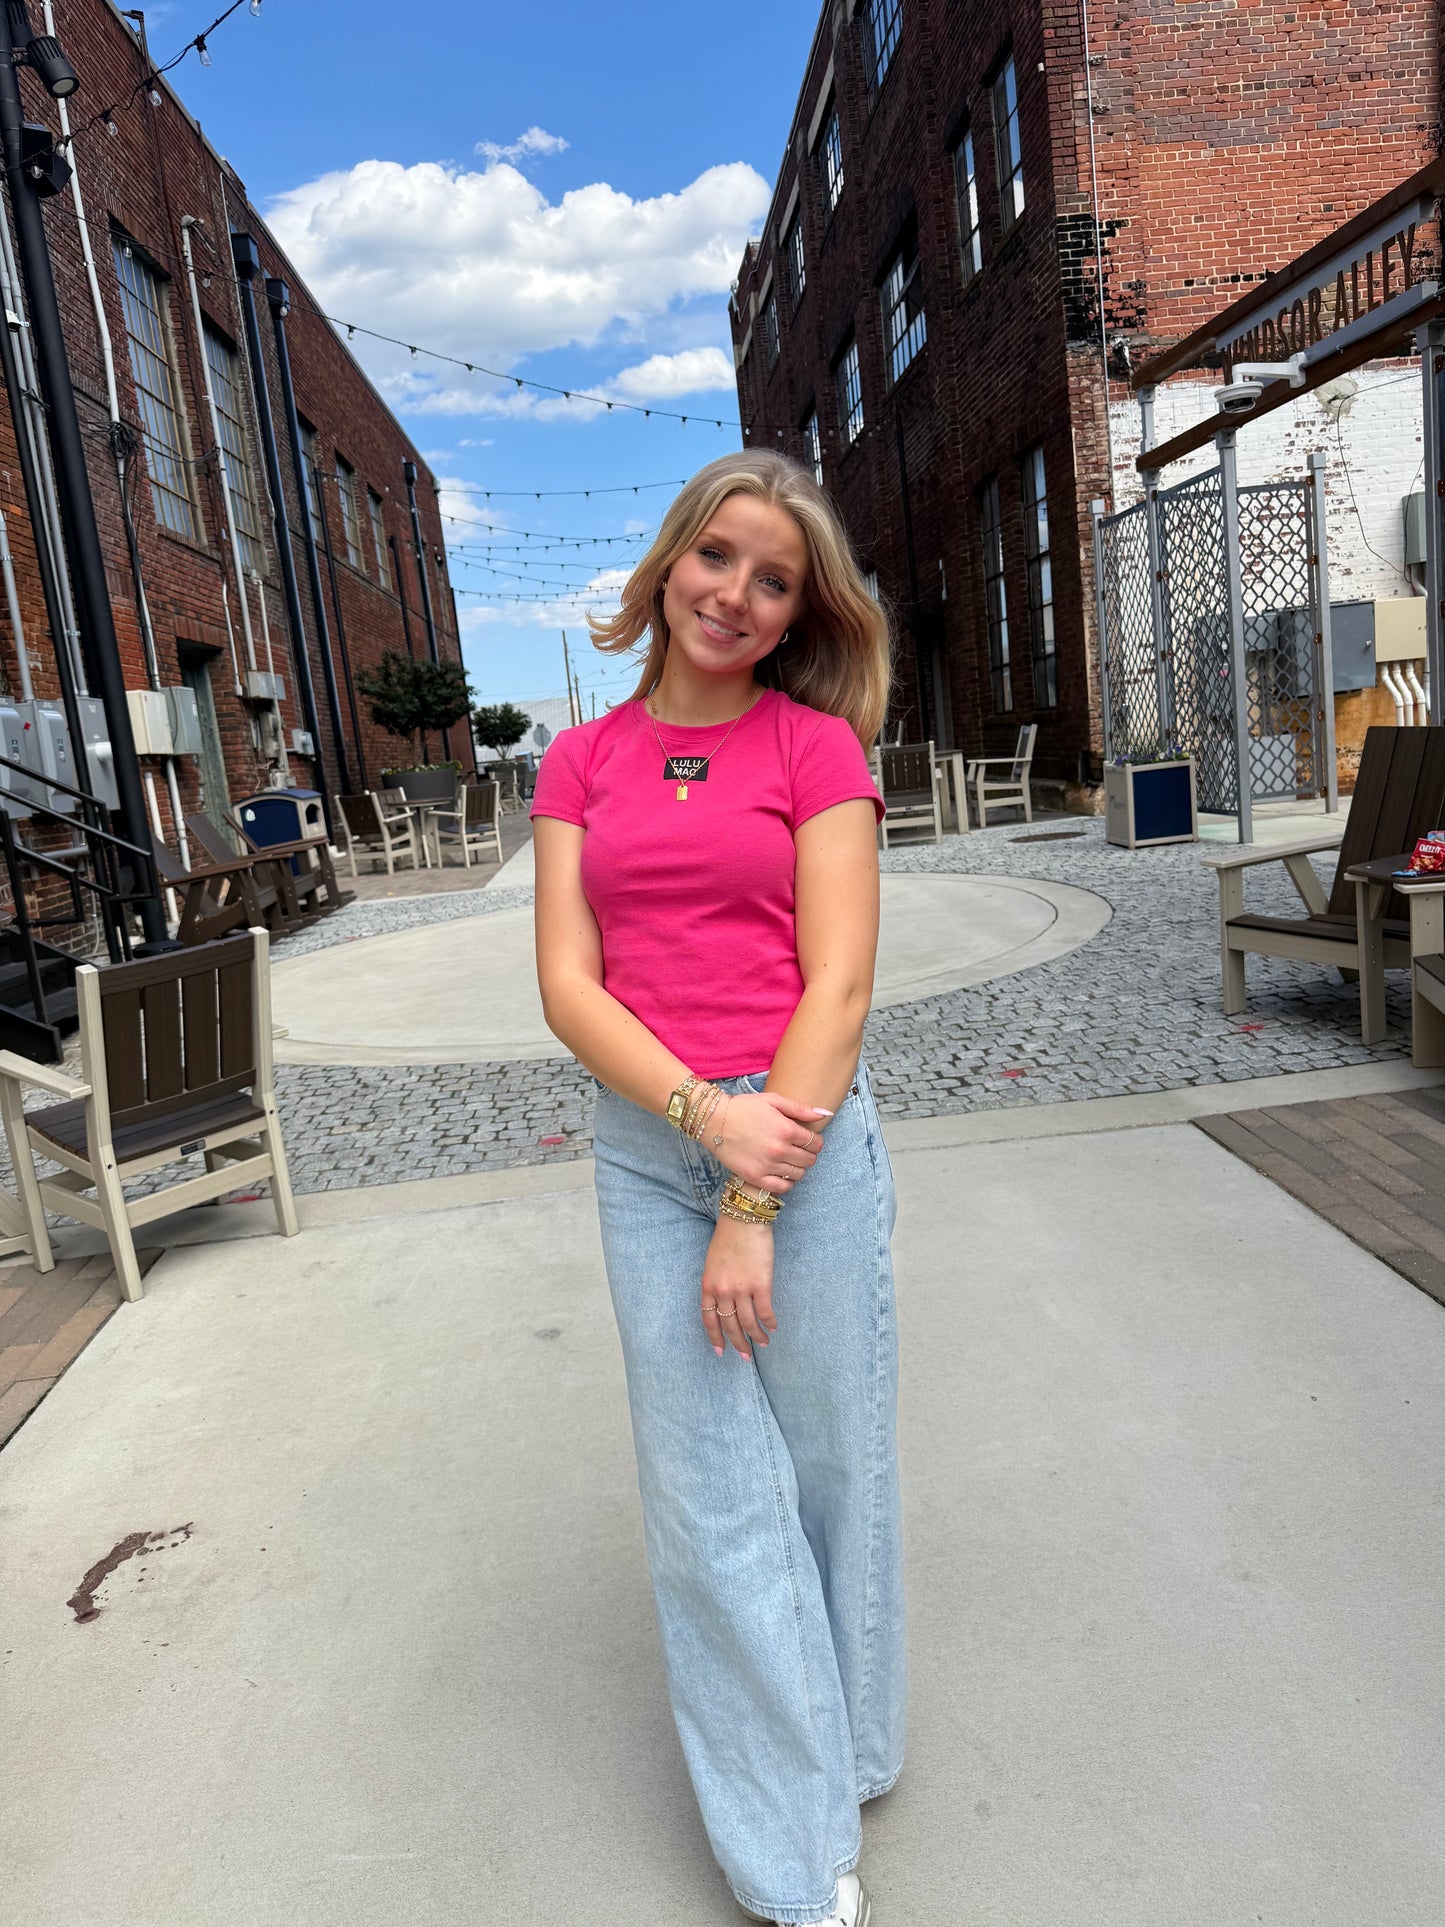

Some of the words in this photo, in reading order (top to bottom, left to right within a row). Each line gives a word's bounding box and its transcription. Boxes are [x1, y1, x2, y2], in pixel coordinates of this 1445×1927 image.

[1219, 287, 1323, 387] WINDSOR
[1333, 221, 1416, 333] ALLEY
[673, 759, 701, 768] LULU
